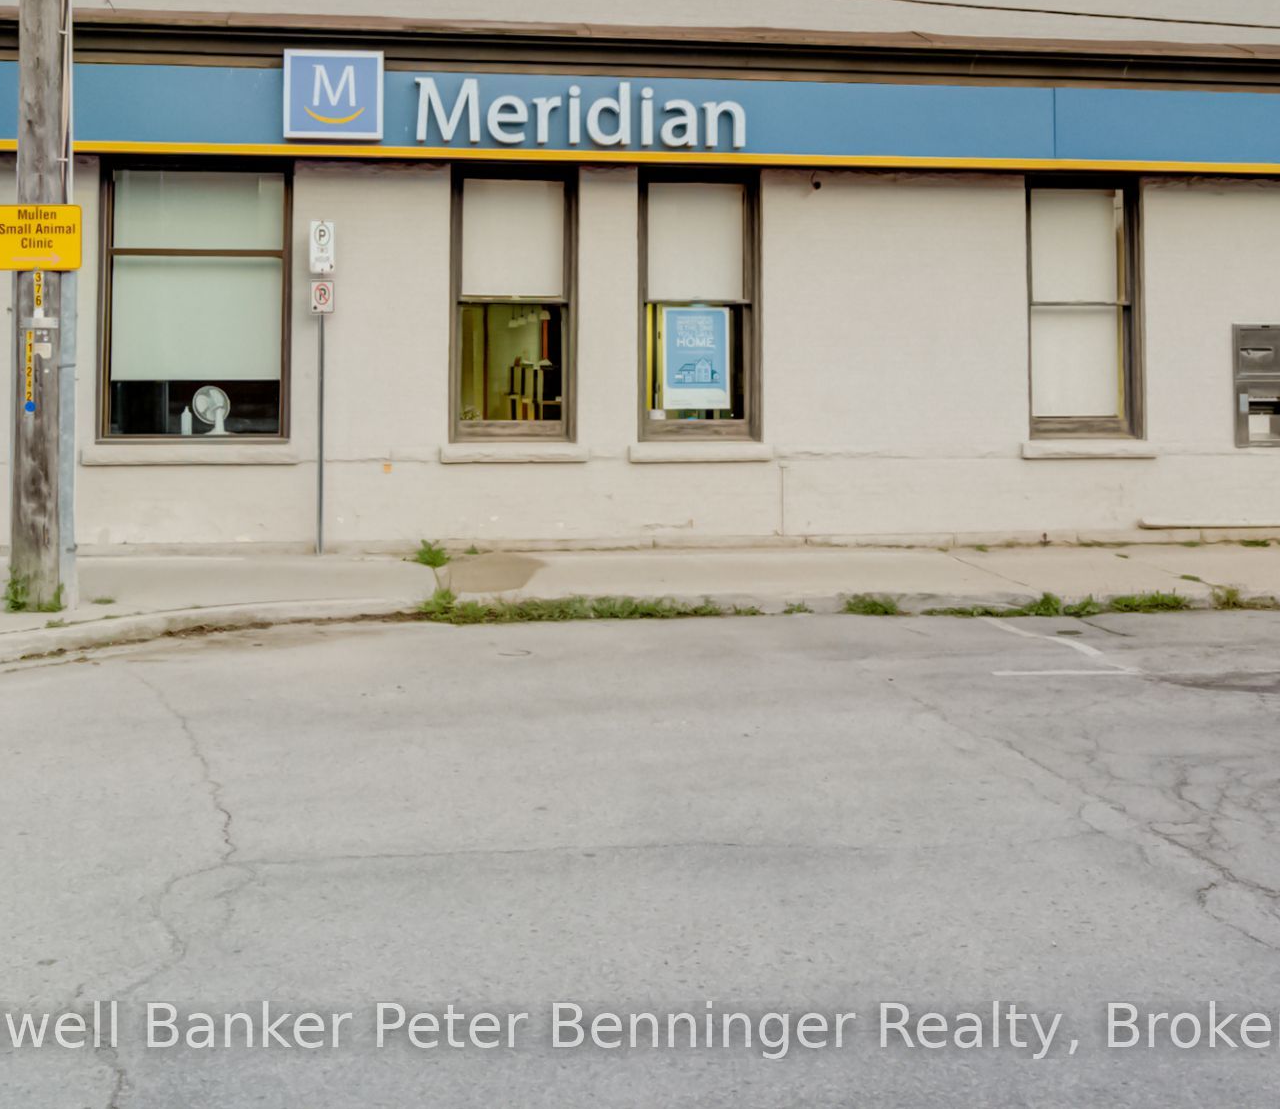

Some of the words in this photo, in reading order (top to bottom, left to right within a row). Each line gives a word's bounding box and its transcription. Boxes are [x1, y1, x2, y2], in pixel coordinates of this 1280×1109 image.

[312, 64, 357, 107] M
[415, 77, 747, 149] Meridian
[17, 209, 57, 220] Mullen
[35, 223, 76, 235] Animal
[20, 237, 54, 249] Clinic
